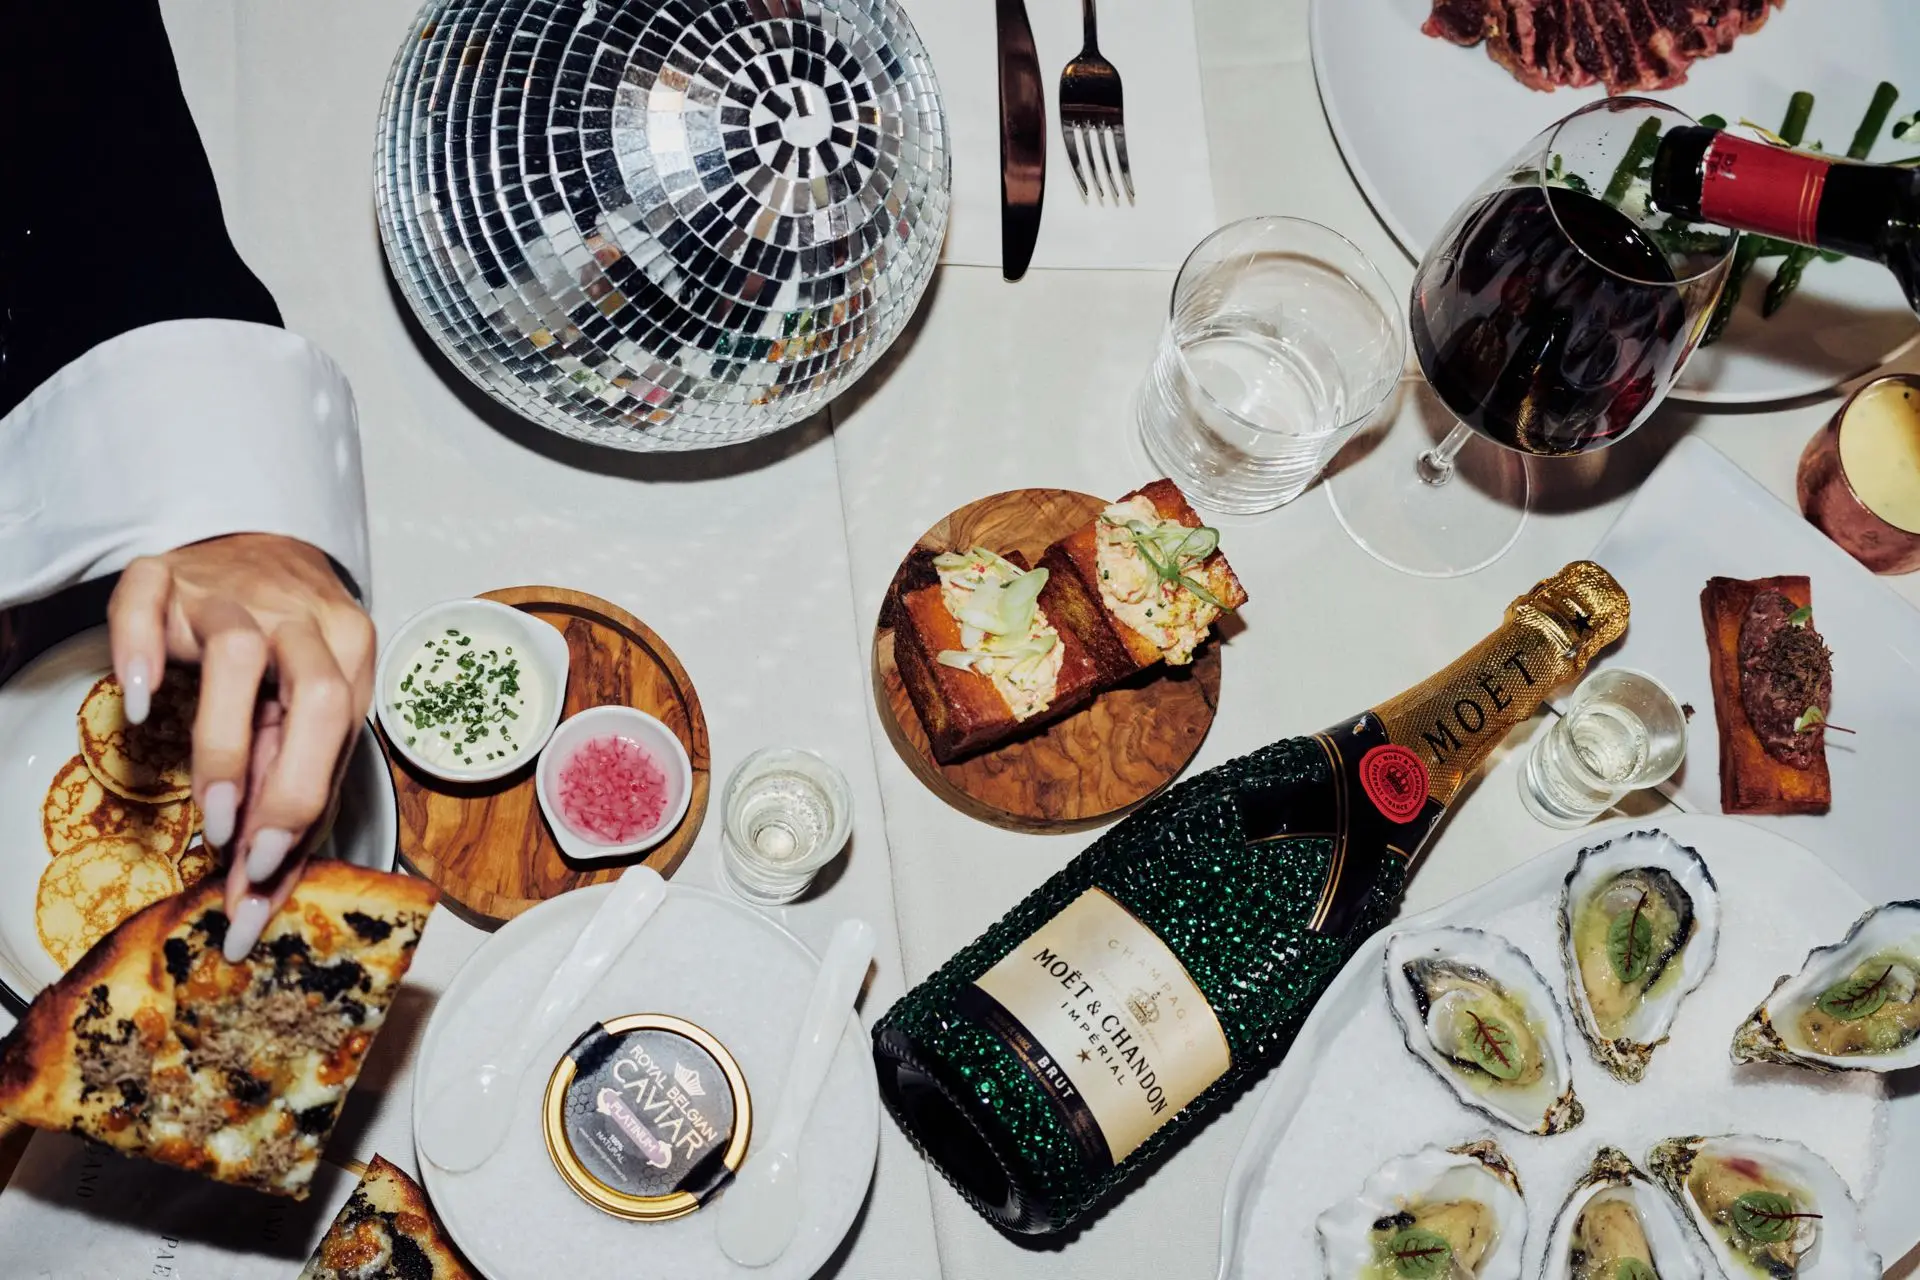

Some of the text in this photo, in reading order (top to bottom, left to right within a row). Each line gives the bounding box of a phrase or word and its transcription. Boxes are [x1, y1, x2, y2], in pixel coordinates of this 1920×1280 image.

[1032, 946, 1094, 1001] MOËT
[1086, 999, 1102, 1016] &
[1100, 1013, 1169, 1116] CHANDON
[1107, 937, 1197, 1052] CHAMPAGNE
[1037, 1055, 1075, 1098] BRUT
[1060, 1001, 1126, 1086] IMPÉRIAL
[610, 1101, 661, 1152] PLATINUM
[612, 1059, 703, 1160] CAVIAR
[629, 1043, 718, 1143] ROYAL BELGIAN
[595, 1131, 625, 1165] NATURAL
